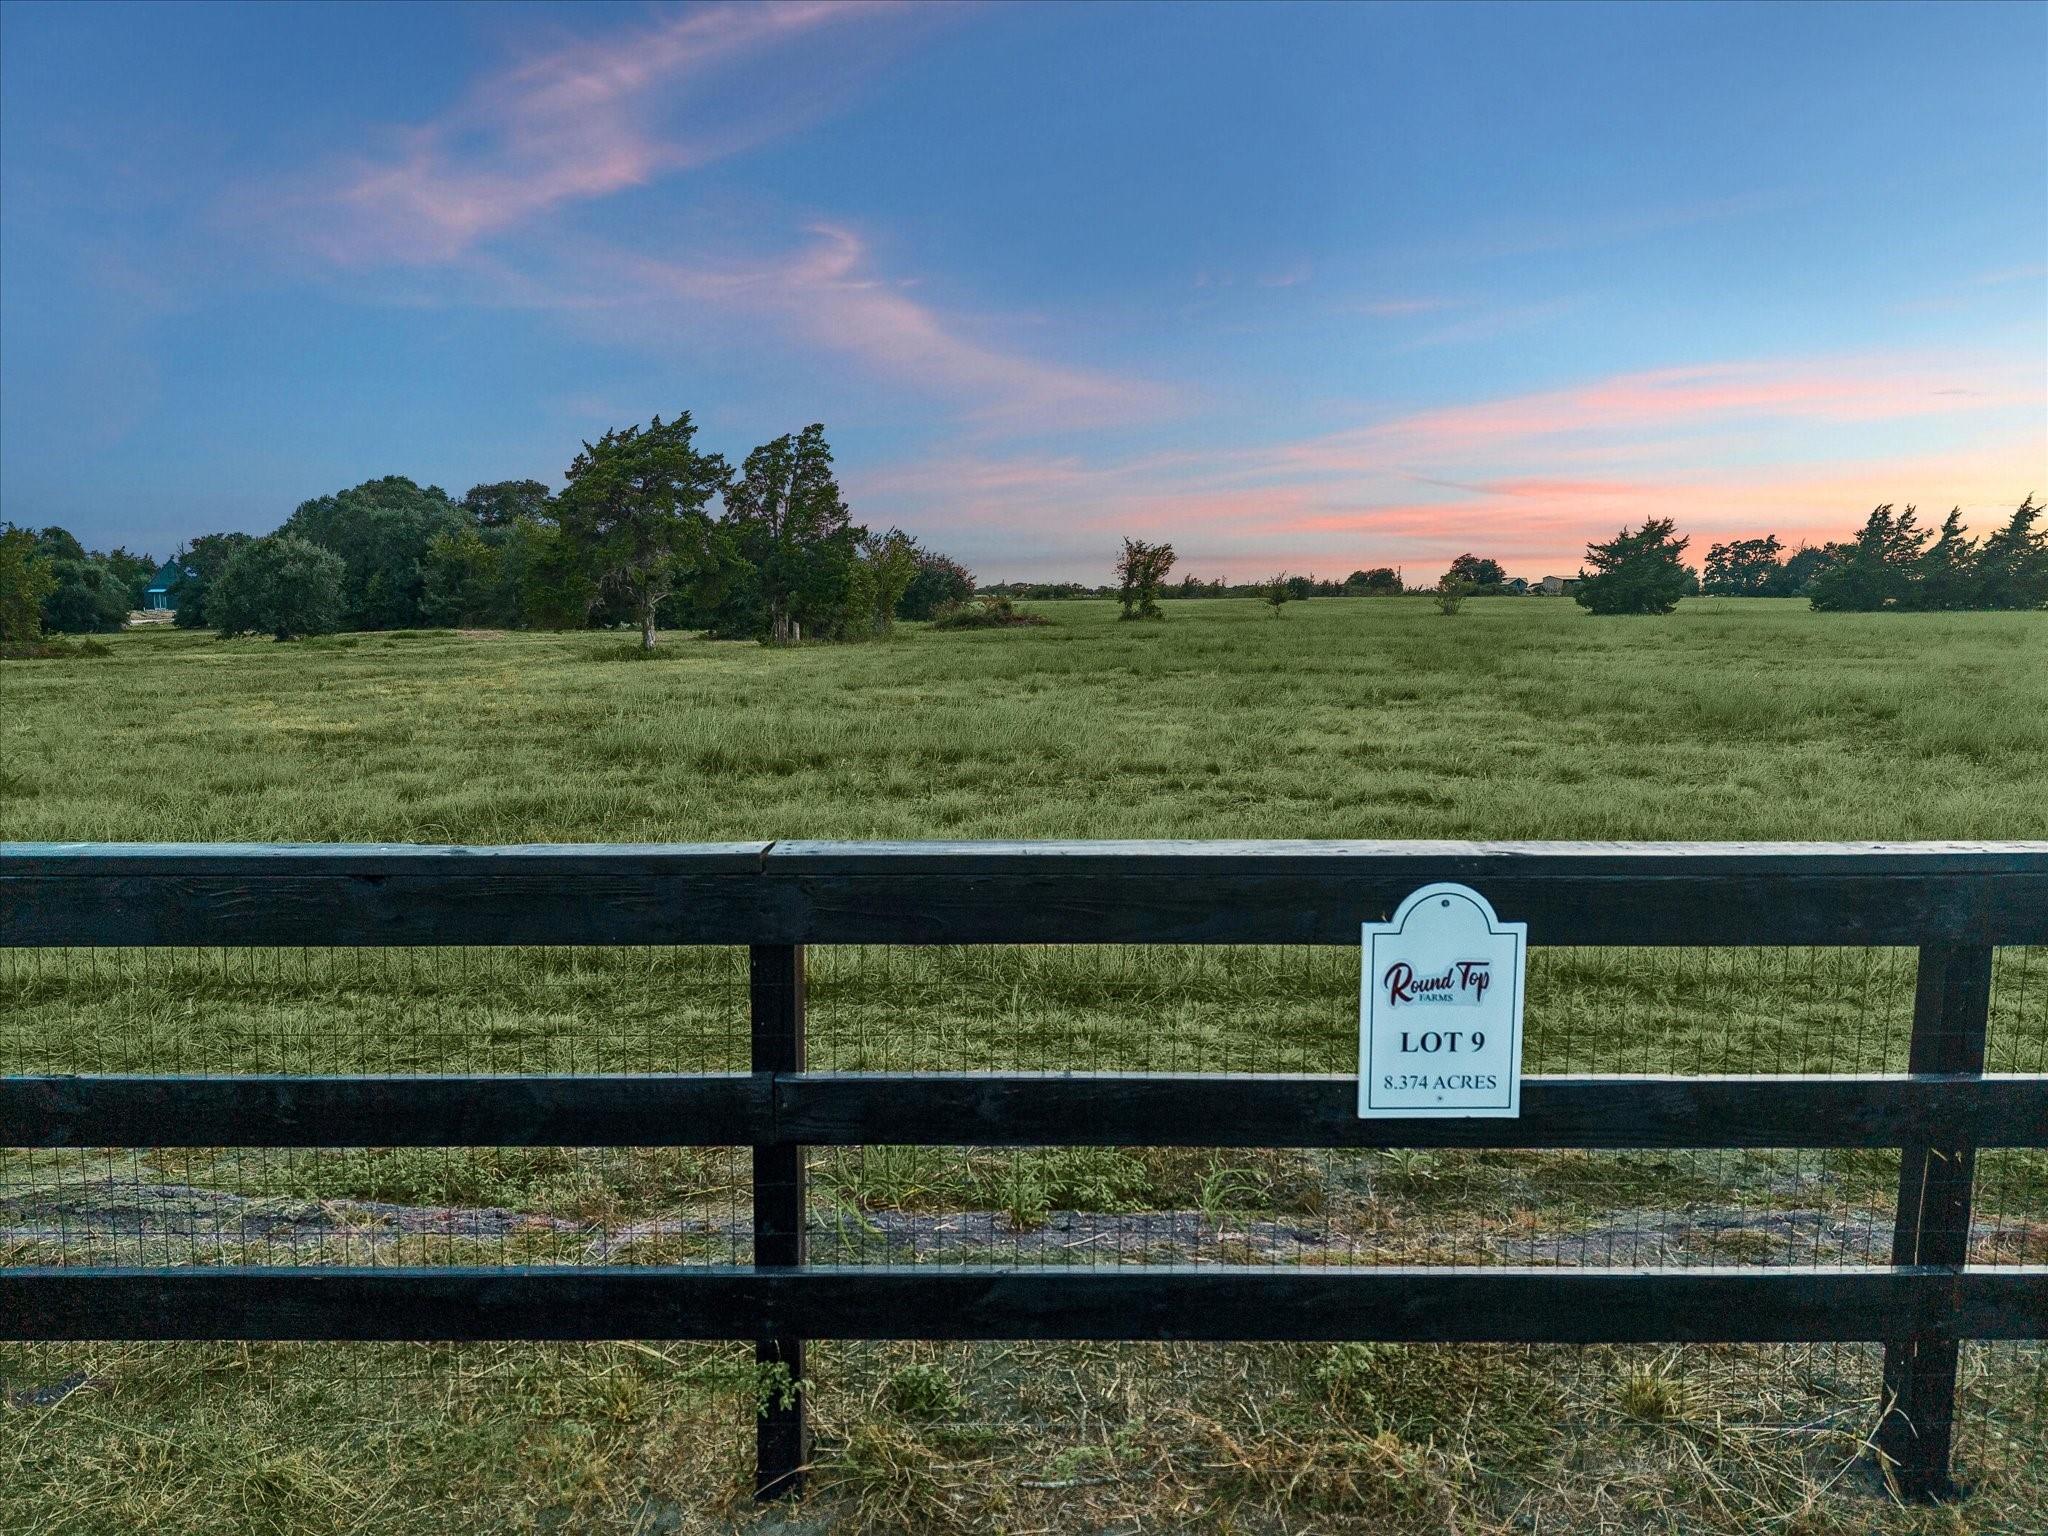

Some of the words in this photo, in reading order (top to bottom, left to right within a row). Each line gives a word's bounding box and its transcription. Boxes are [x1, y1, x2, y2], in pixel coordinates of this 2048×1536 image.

[1384, 962, 1455, 1006] Round
[1456, 961, 1491, 1002] Top
[1418, 993, 1453, 1002] FARMS
[1400, 1031, 1463, 1053] LOT
[1471, 1031, 1486, 1053] 9
[1384, 1075, 1428, 1090] 8.374
[1433, 1075, 1497, 1090] ACRES
